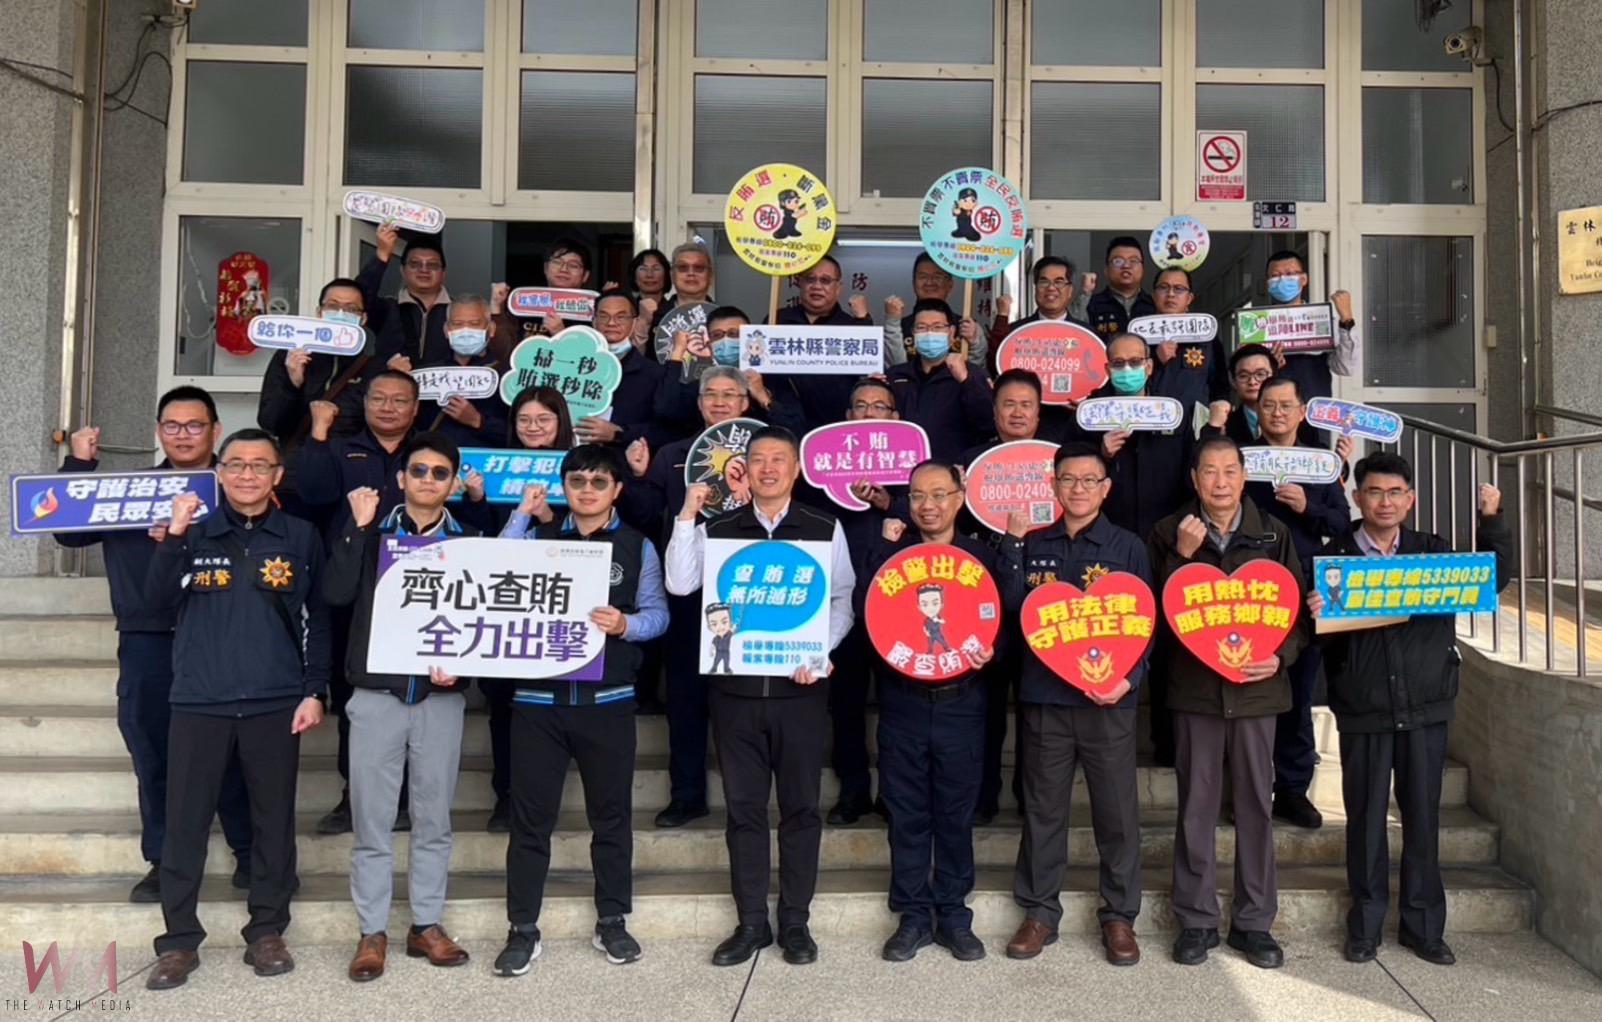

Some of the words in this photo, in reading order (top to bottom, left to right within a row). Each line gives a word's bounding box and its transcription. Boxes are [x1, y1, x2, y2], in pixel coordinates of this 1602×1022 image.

[1271, 216, 1290, 228] 12
[257, 321, 333, 342] 給你一個
[768, 337, 879, 356] 雲林縣警察局
[534, 347, 597, 374] 掃一秒
[1011, 357, 1080, 371] 0800-024099
[842, 431, 888, 451] 不賄
[484, 455, 563, 475] 打擊犯
[813, 450, 918, 471] 就是有智慧
[66, 476, 189, 500] 守護治安
[400, 567, 573, 615] 齊心查賄
[726, 584, 809, 606] 無所遁形
[1183, 578, 1280, 606] 用熱忱
[1037, 593, 1137, 627] 用法律
[1174, 603, 1291, 634] 服務鄉親
[417, 614, 590, 662] 全力出擊
[1027, 614, 1152, 649] 守護正義
